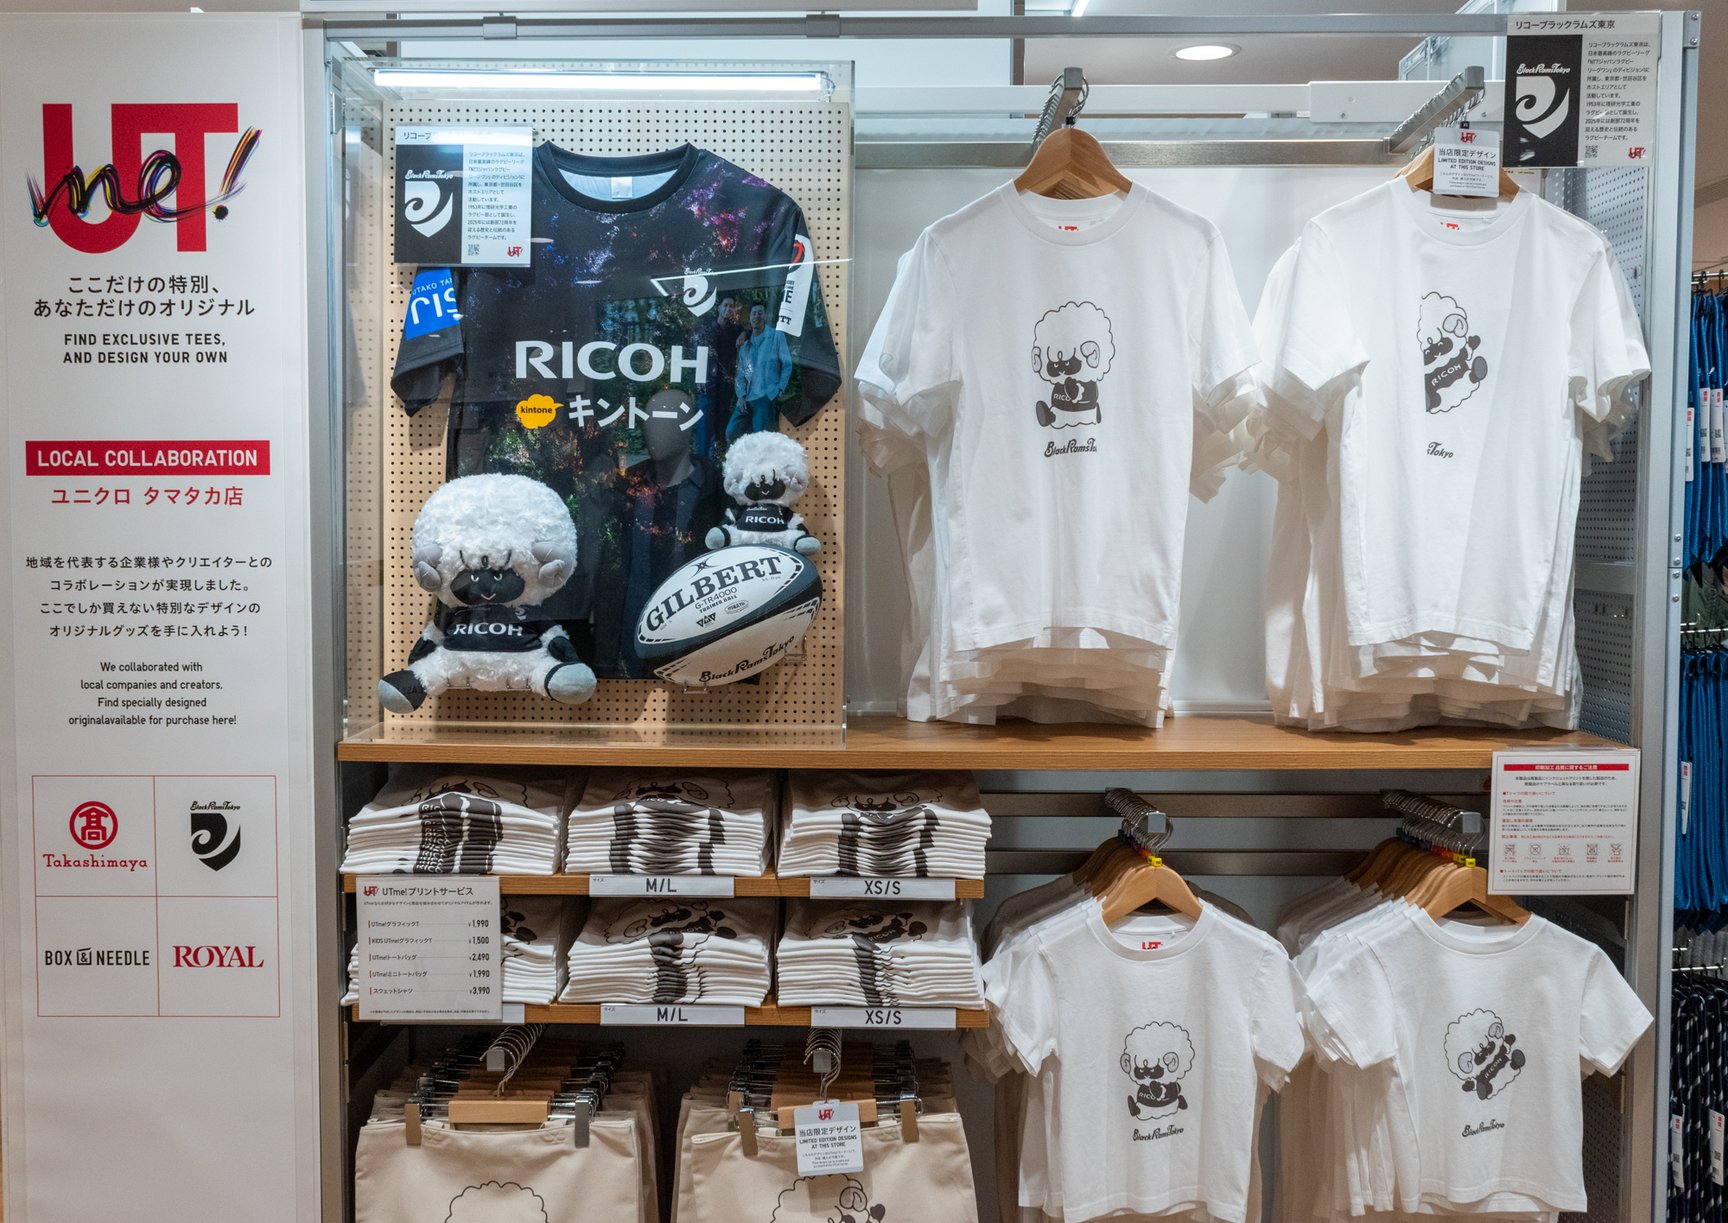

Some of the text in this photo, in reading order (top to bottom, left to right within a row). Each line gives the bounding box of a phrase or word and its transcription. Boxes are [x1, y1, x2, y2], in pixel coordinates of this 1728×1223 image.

[1515, 19, 1616, 30] リコーブラックラムズ東京
[1439, 148, 1497, 159] 当店限定デザイン
[42, 103, 238, 254] UT
[68, 275, 222, 294] ここだけの特別、
[33, 298, 256, 317] あなただけのオリジナル
[64, 333, 226, 347] FIND EXCLUSIVE TEES,
[63, 352, 228, 363] AND DESIGN YOUR OWN
[515, 340, 709, 384] RICOH
[1431, 363, 1462, 386] RICOH
[520, 395, 704, 432] kintone キントーン
[37, 450, 258, 467] LOCAL COLLABORATION
[51, 486, 244, 506] ユニクロ タマタカ店
[745, 516, 785, 525] RICOH
[25, 556, 273, 569] 地域を代表する企業様やクリエイターとの
[50, 579, 250, 592] コラボレーションが実現しました。
[646, 556, 782, 632] GILBERT
[695, 587, 738, 610] G-TR4000
[40, 602, 261, 614] ここでしか買えない特別なデザインの
[453, 622, 523, 637] RICOH
[100, 662, 203, 672] We collaborated with
[80, 680, 223, 691] local companies and creators.
[97, 697, 207, 710] Find specially designed
[68, 715, 237, 727] originalavailable for purchase here!
[42, 853, 148, 872] Takashimaya
[646, 878, 677, 893] M/L
[864, 880, 901, 895] XS/S
[45, 950, 73, 966] BOX
[96, 950, 150, 966] NEEDLE
[172, 945, 265, 968] ROYAL
[657, 1007, 688, 1022] M/L
[865, 1009, 902, 1025] XS/S
[799, 1126, 857, 1137] 当店限定デザイン
